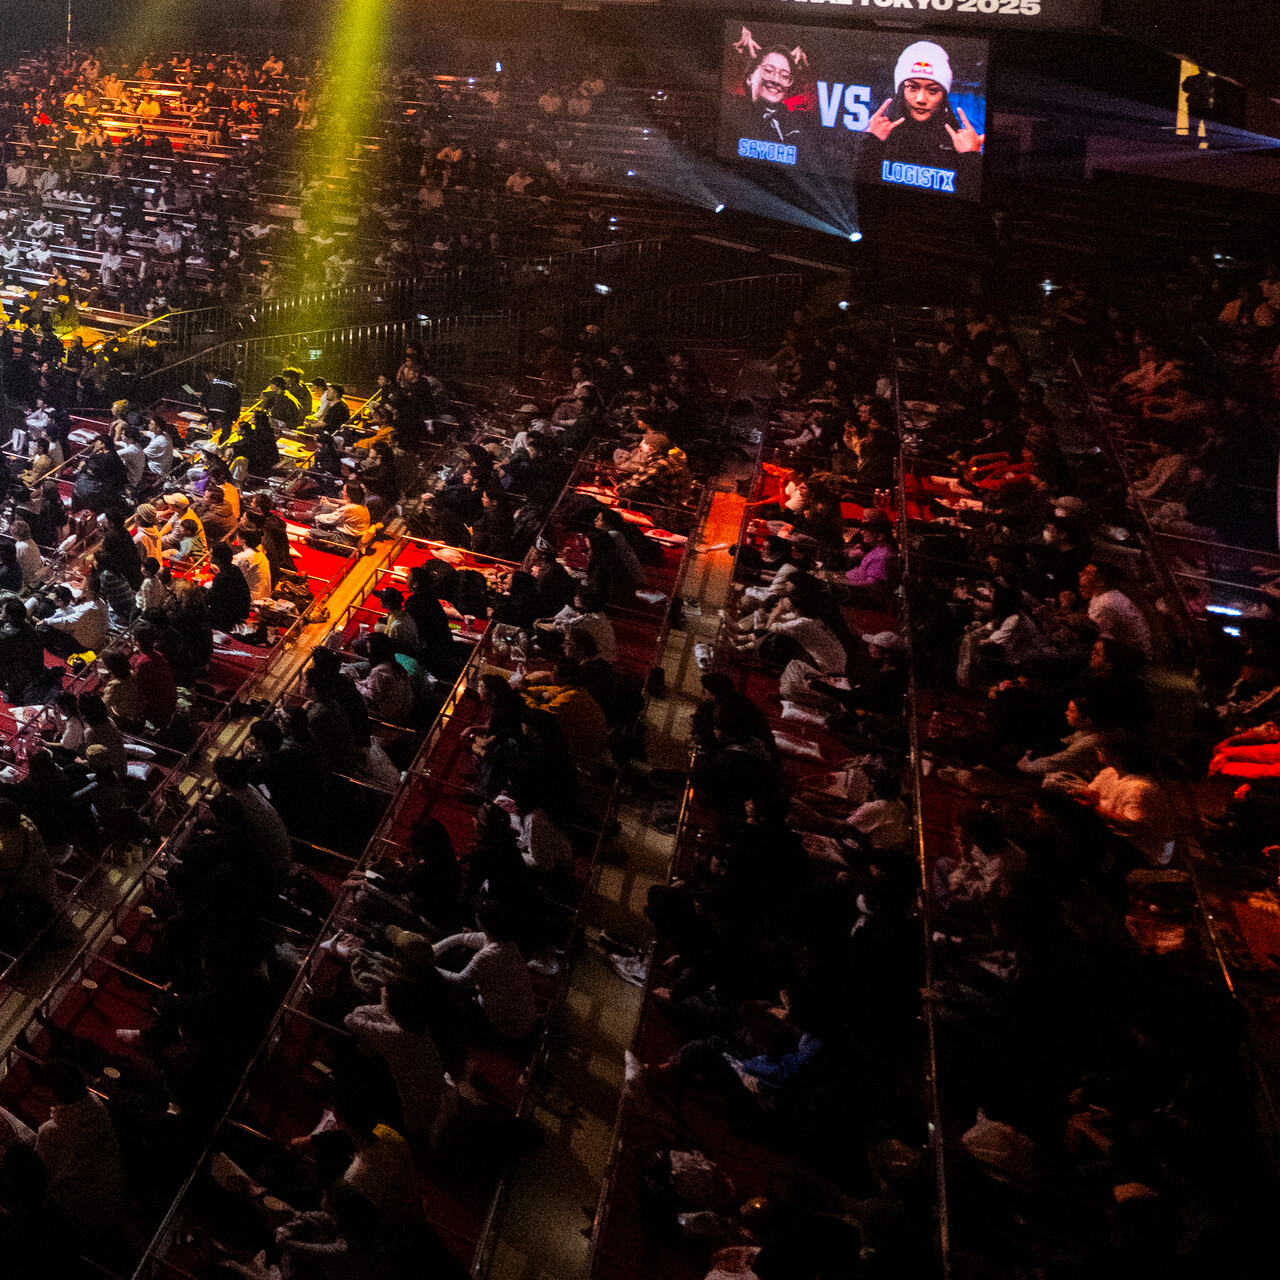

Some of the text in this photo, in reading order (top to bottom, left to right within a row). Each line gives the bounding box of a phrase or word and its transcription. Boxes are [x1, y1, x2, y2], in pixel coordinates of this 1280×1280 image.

[817, 81, 871, 131] VS
[738, 138, 797, 165] SAYORA
[882, 161, 956, 192] LOGISTX
